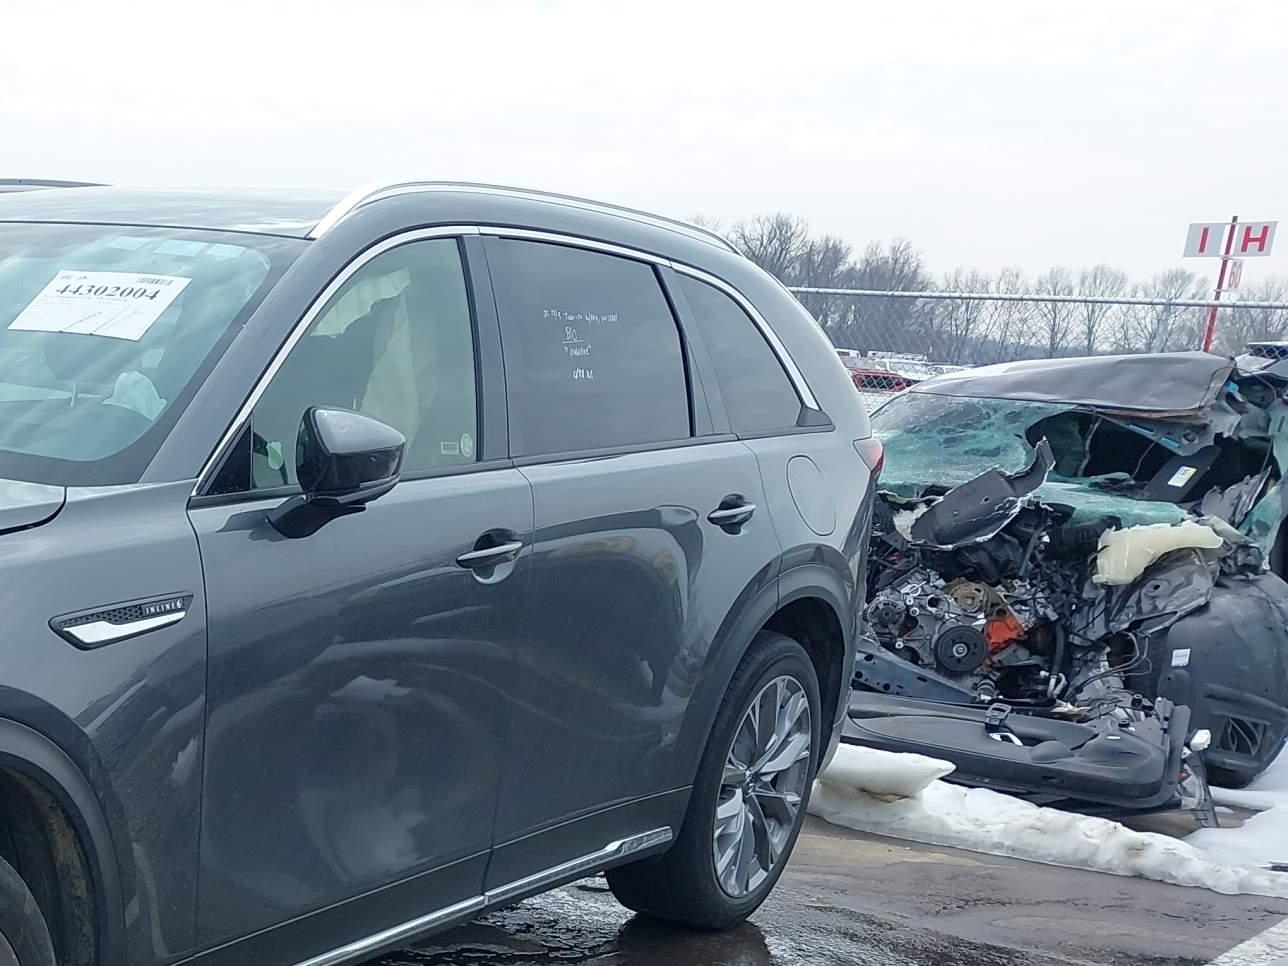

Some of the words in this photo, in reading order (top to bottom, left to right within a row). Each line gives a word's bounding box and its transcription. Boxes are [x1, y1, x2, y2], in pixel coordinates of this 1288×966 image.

[1198, 226, 1210, 253] I
[1240, 225, 1270, 253] H
[55, 283, 161, 301] 44302004
